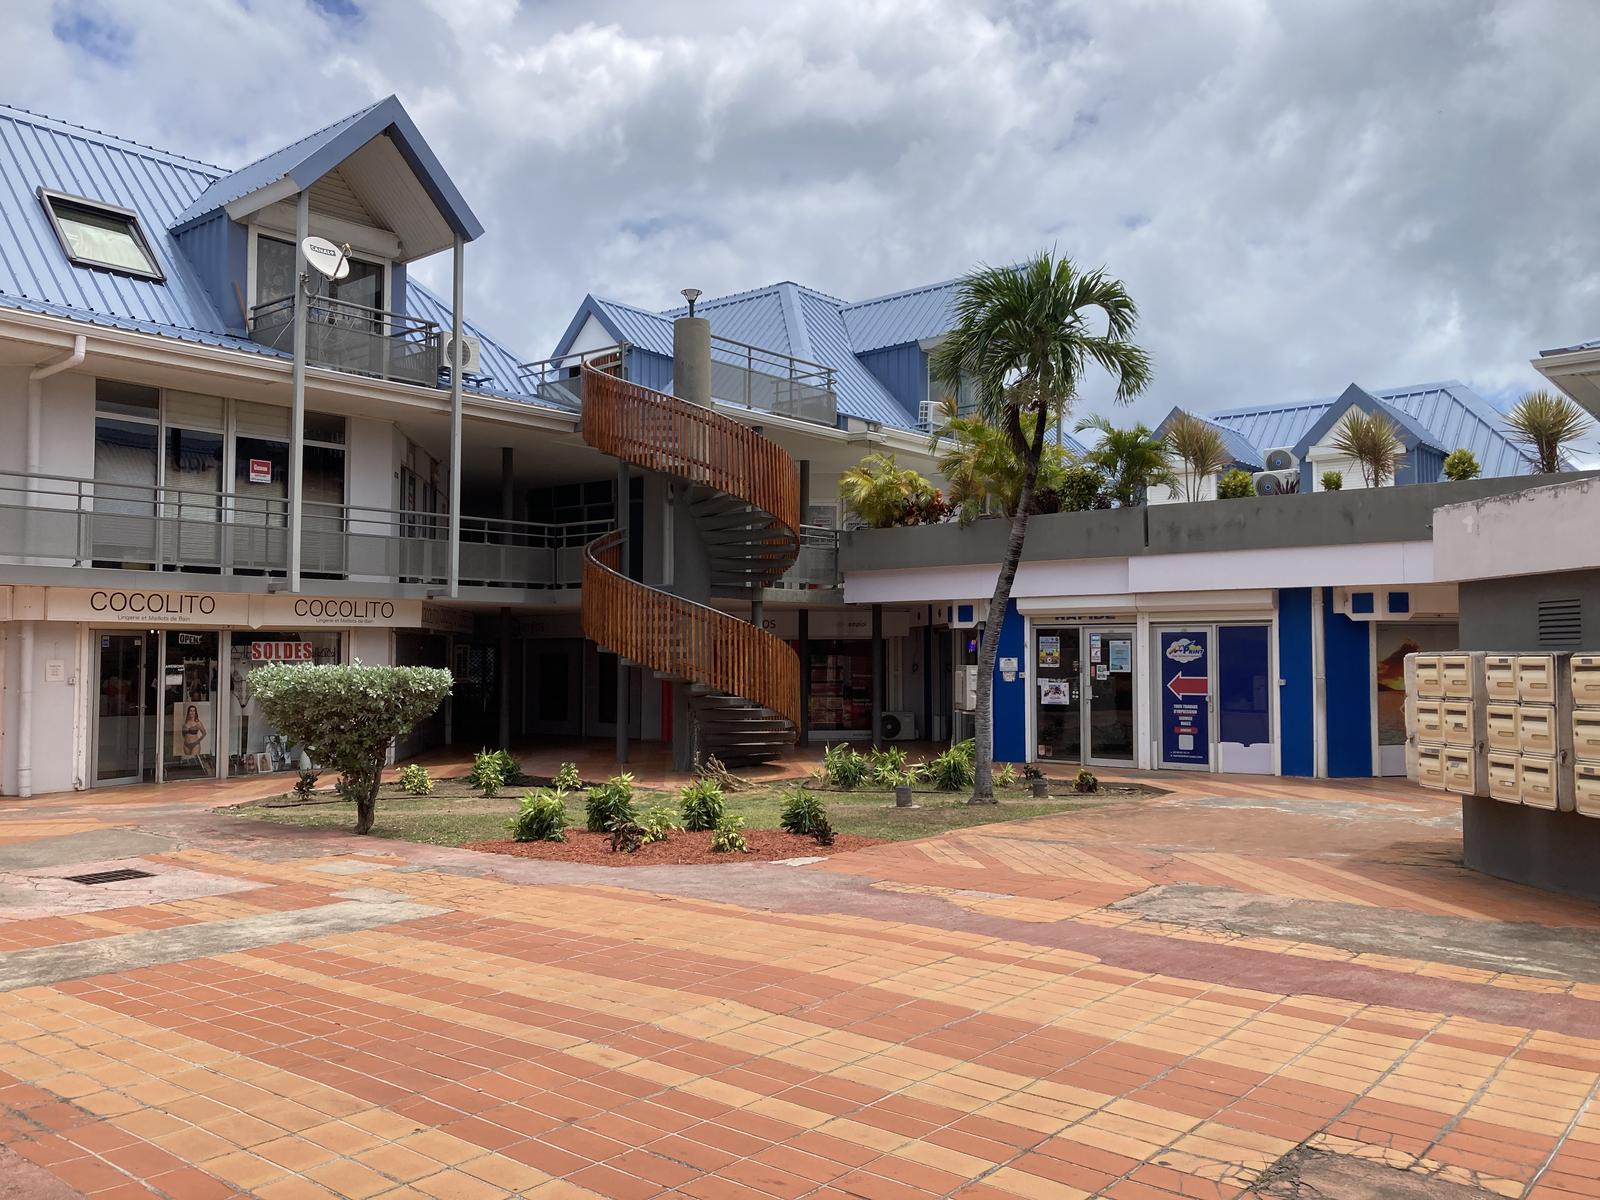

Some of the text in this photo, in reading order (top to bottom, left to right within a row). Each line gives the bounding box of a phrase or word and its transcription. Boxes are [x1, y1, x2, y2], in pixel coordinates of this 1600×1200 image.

[310, 245, 335, 256] CANAL+
[90, 591, 215, 614] COCOLITO
[294, 599, 394, 618] COCOLITO
[179, 634, 199, 644] OPEN
[252, 642, 312, 659] SOLDES
